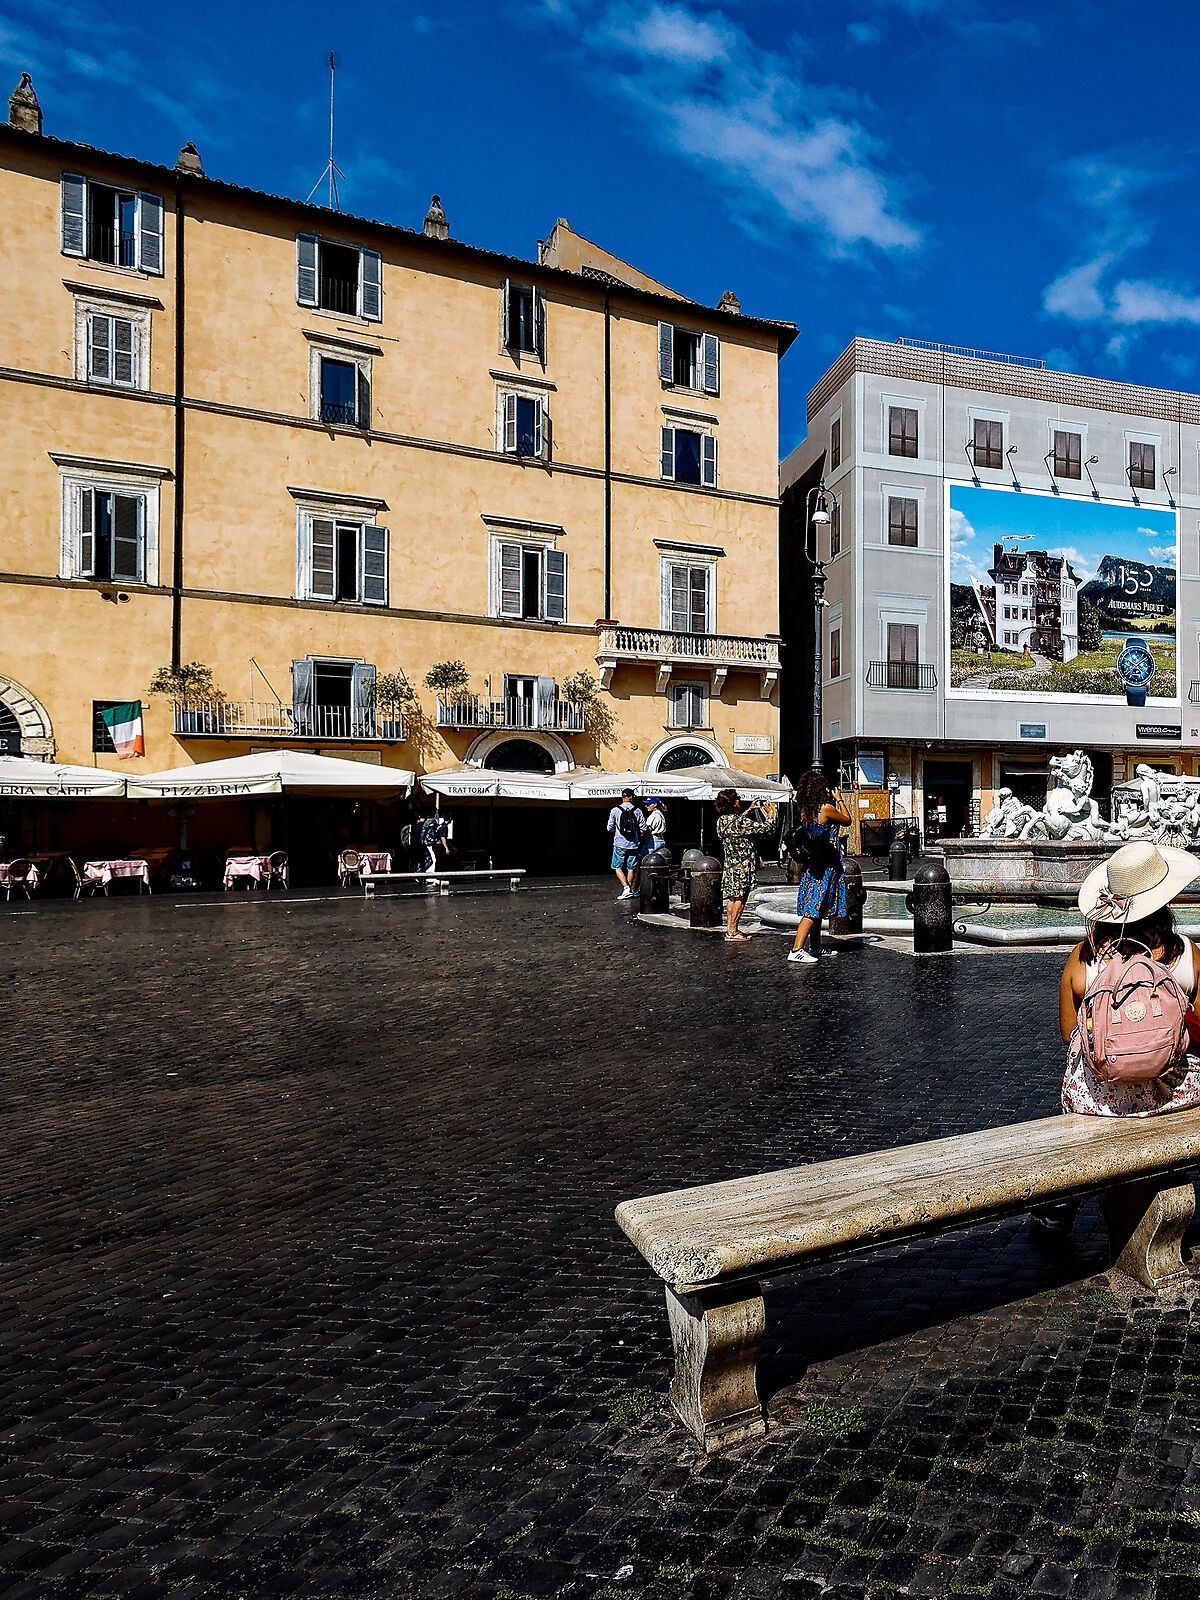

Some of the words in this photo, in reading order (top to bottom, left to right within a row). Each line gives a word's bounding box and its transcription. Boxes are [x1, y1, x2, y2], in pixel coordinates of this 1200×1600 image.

[1142, 601, 1165, 613] PIGUET
[160, 783, 251, 796] PIZZERIA
[447, 786, 490, 794] TRATTORIA
[587, 788, 612, 796] CUCINA
